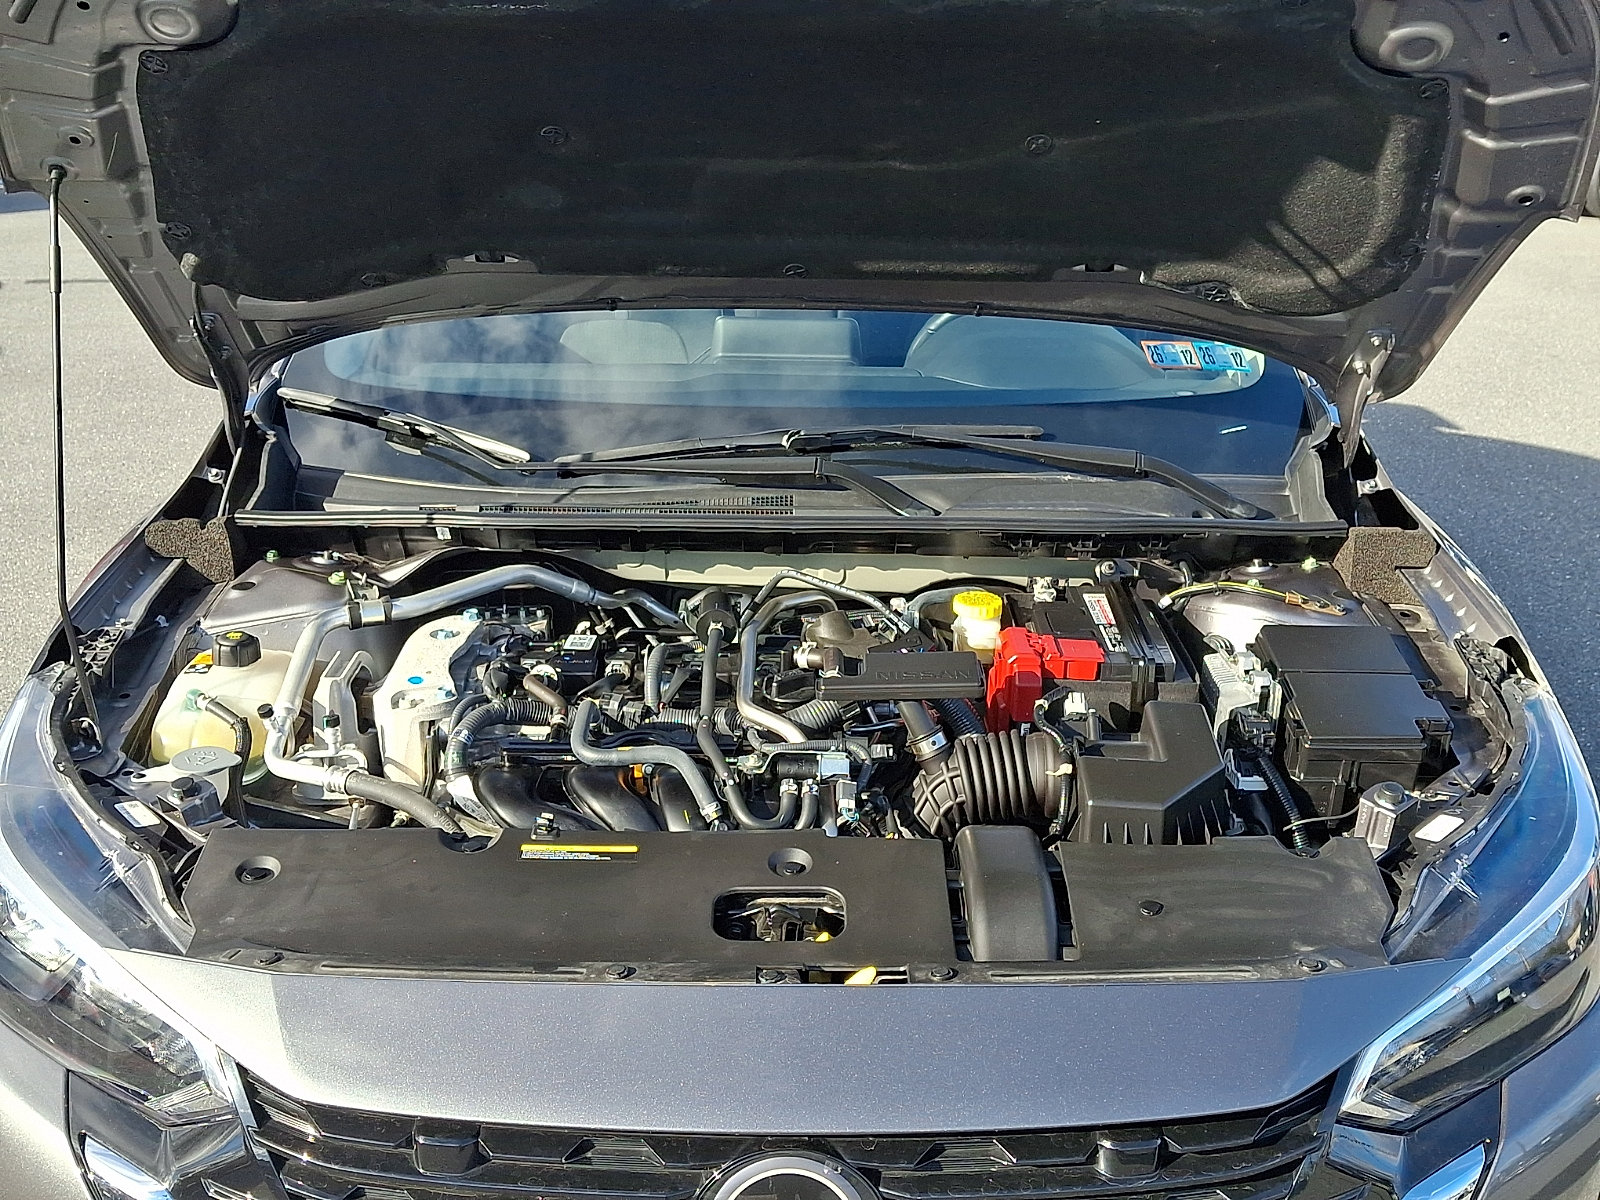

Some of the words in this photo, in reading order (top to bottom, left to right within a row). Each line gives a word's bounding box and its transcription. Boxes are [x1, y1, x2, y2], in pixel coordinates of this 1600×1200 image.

[1147, 345, 1164, 364] 26
[1180, 349, 1197, 365] 12
[1199, 346, 1216, 365] 26
[1230, 351, 1247, 368] 12
[875, 669, 971, 680] NISSAN
